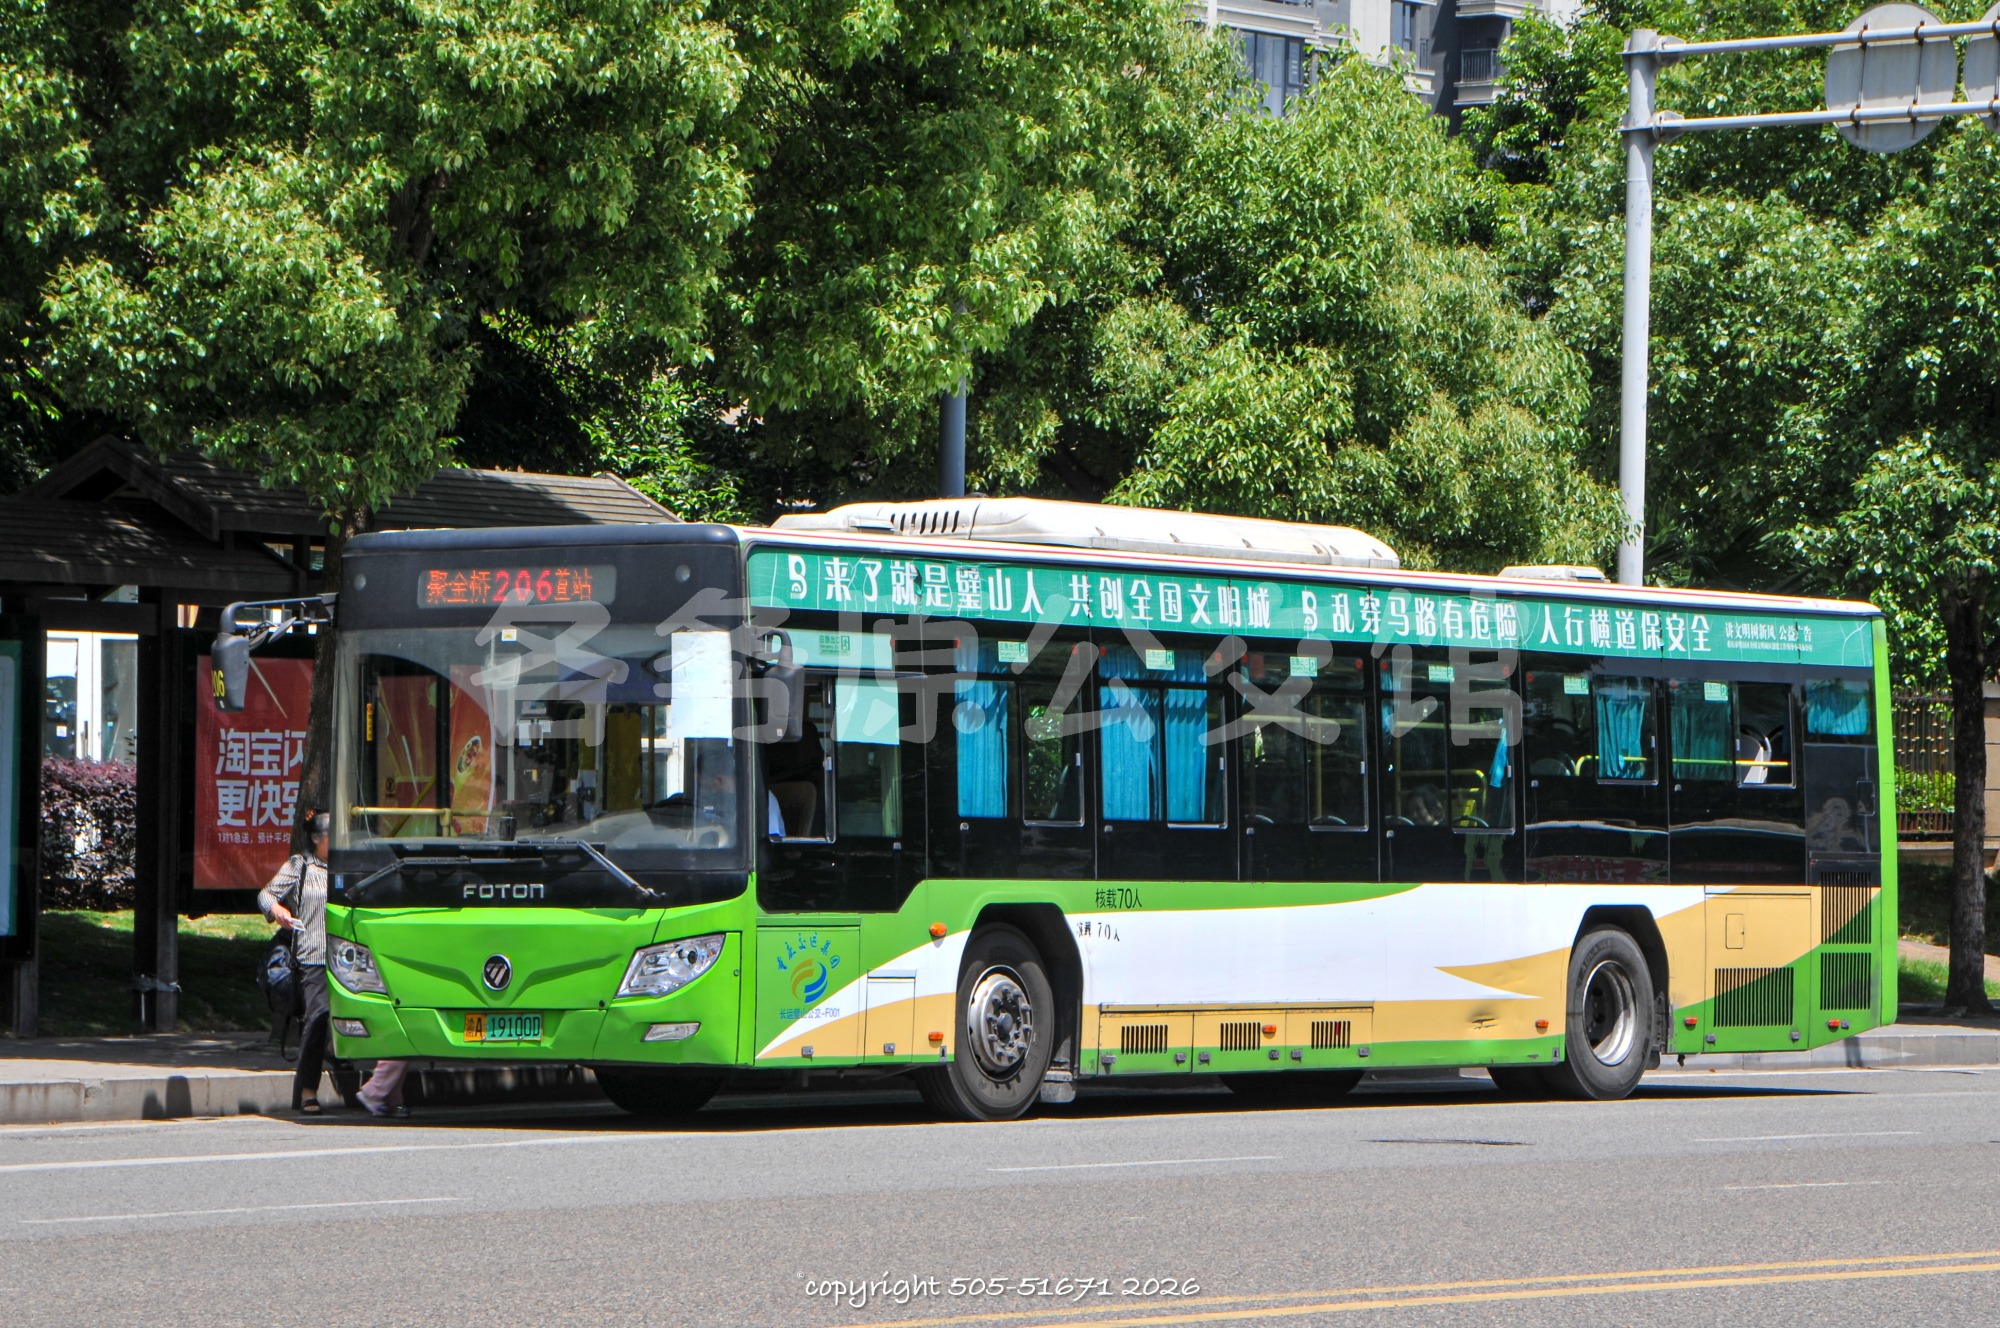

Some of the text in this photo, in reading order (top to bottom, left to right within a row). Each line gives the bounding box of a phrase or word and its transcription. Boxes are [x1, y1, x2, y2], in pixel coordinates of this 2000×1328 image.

[493, 570, 553, 601] 206
[823, 556, 1712, 652] 来了就是璧山人 共创全国文明城 乱穿马路有危险 人行横道保安全
[212, 669, 225, 697] 06
[463, 883, 544, 899] FOTON
[1096, 888, 1142, 909] 核载70人
